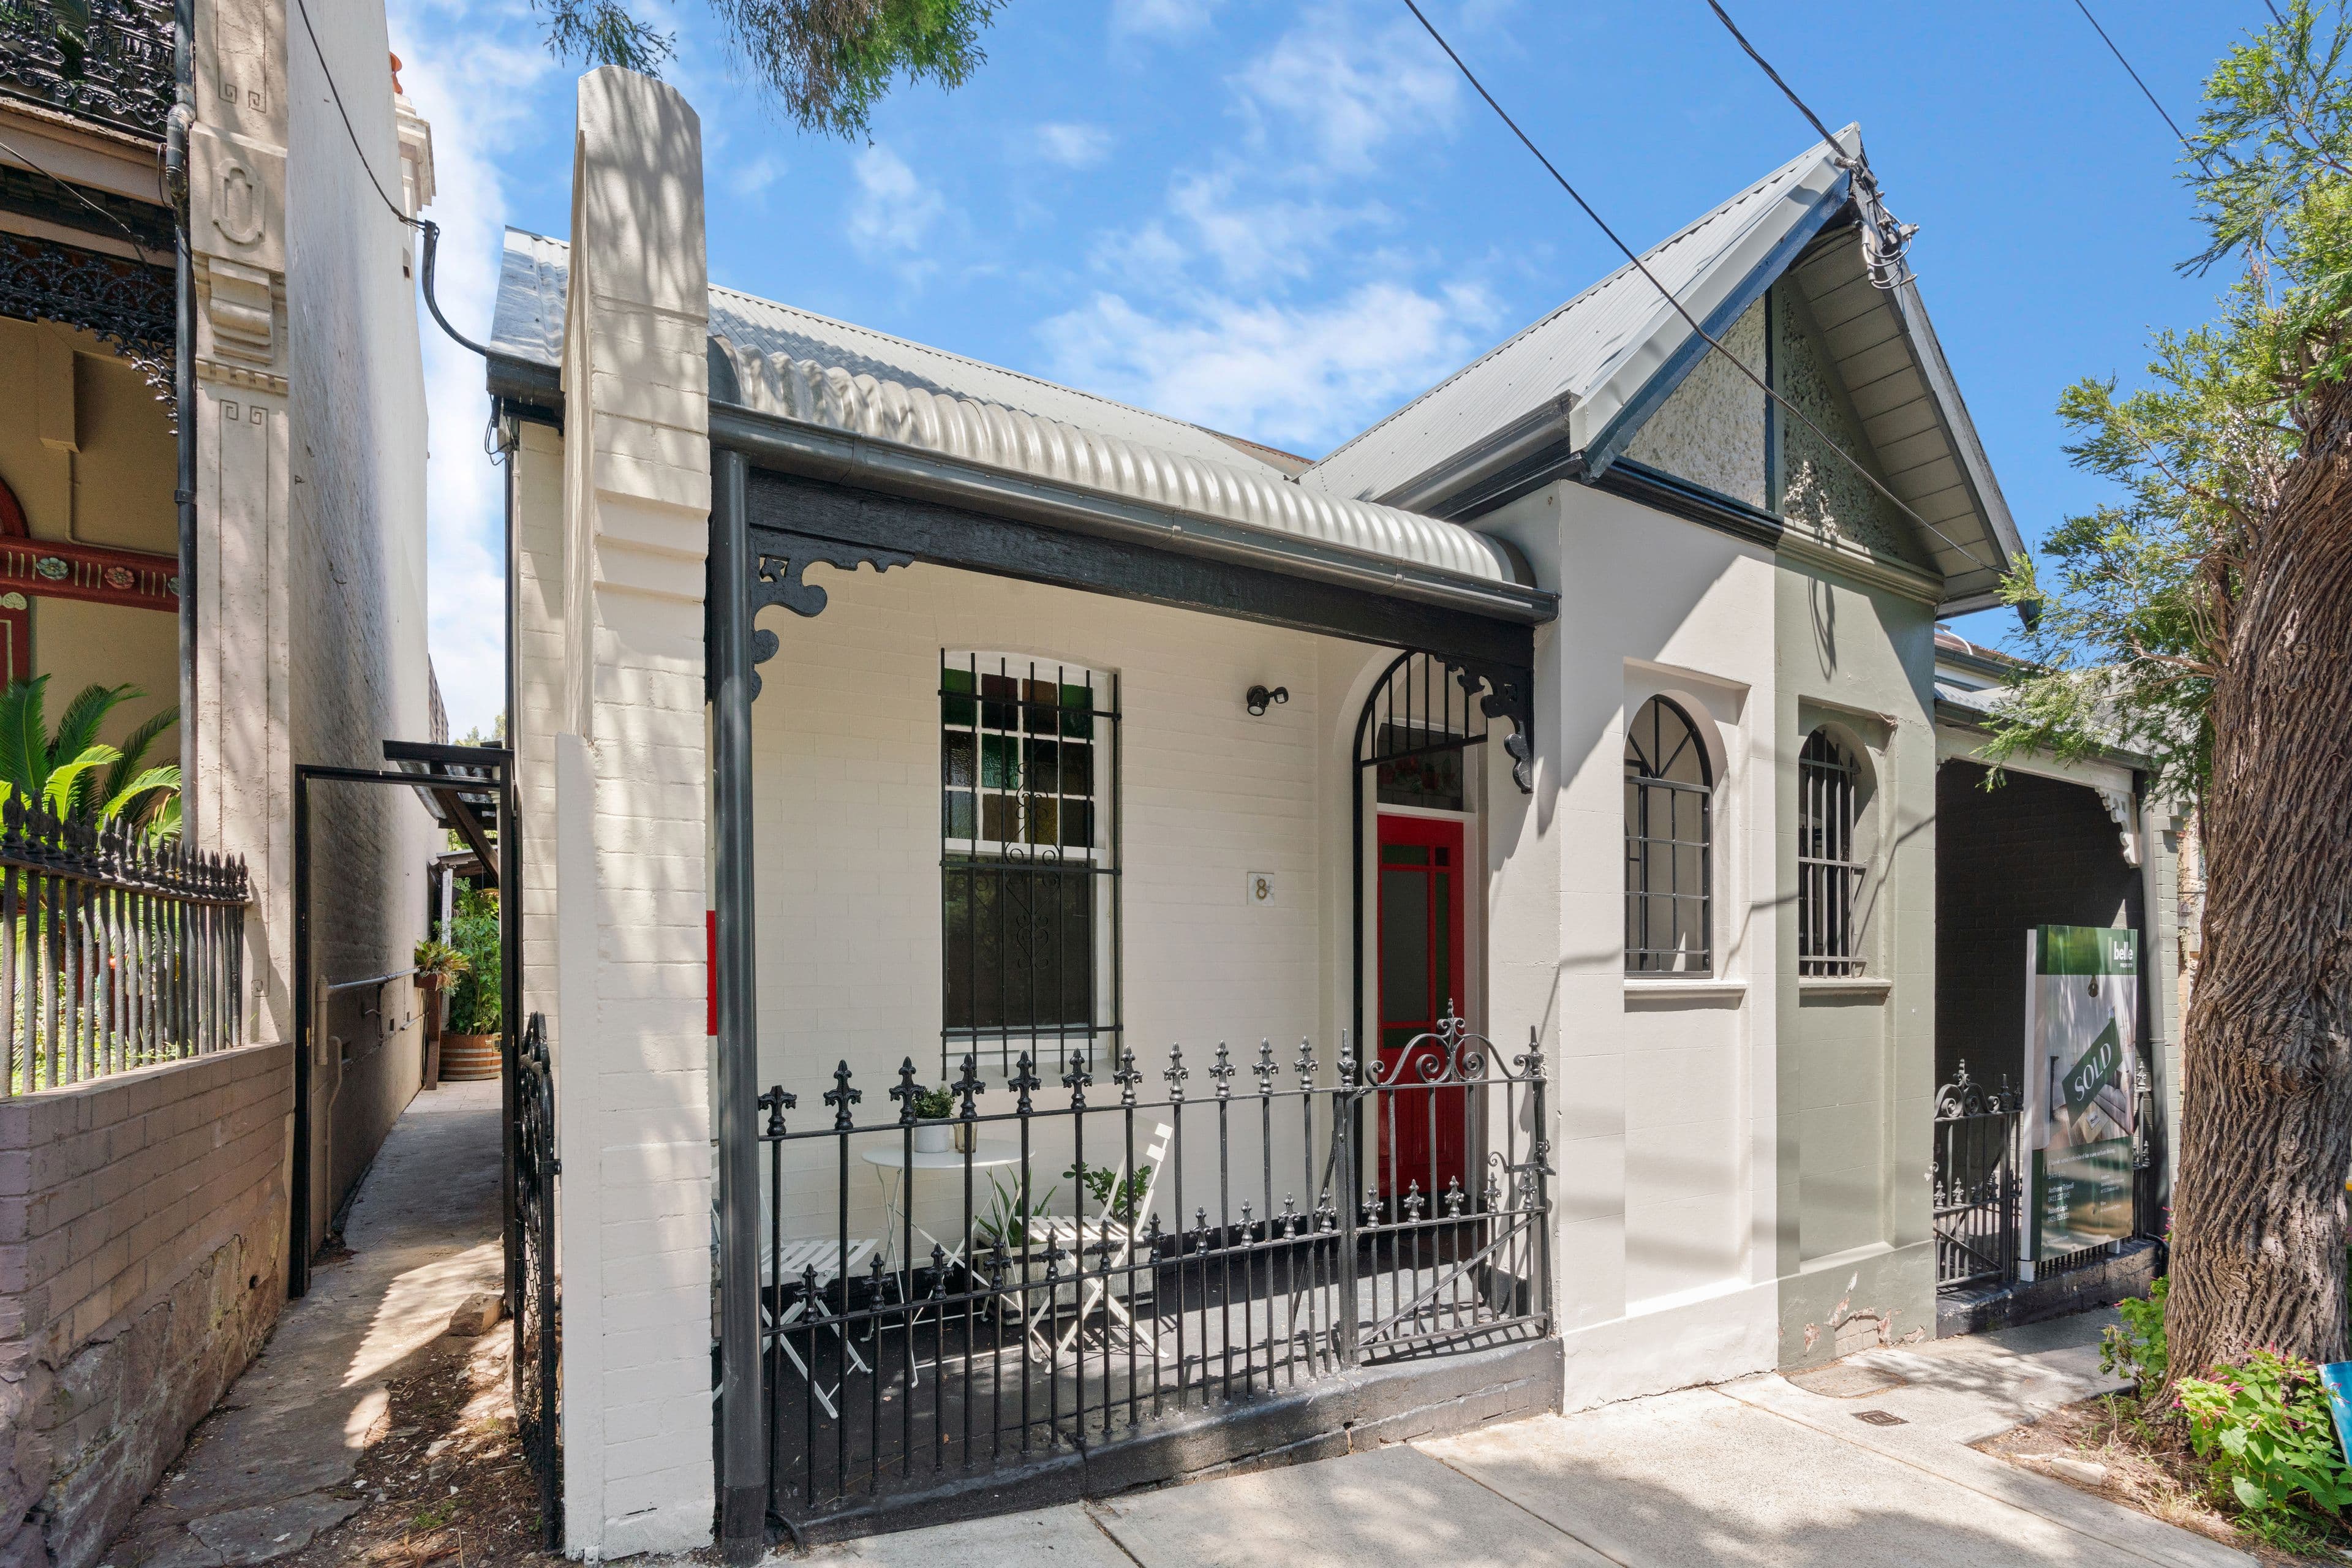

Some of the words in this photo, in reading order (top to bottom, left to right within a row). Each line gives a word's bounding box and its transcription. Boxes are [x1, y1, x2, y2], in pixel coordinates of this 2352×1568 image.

[1256, 878, 1267, 900] 8
[2114, 941, 2133, 960] belle
[2075, 1042, 2111, 1101] SOLD
[2063, 1182, 2075, 1191] Tripodi
[2048, 1206, 2059, 1215] Robert
